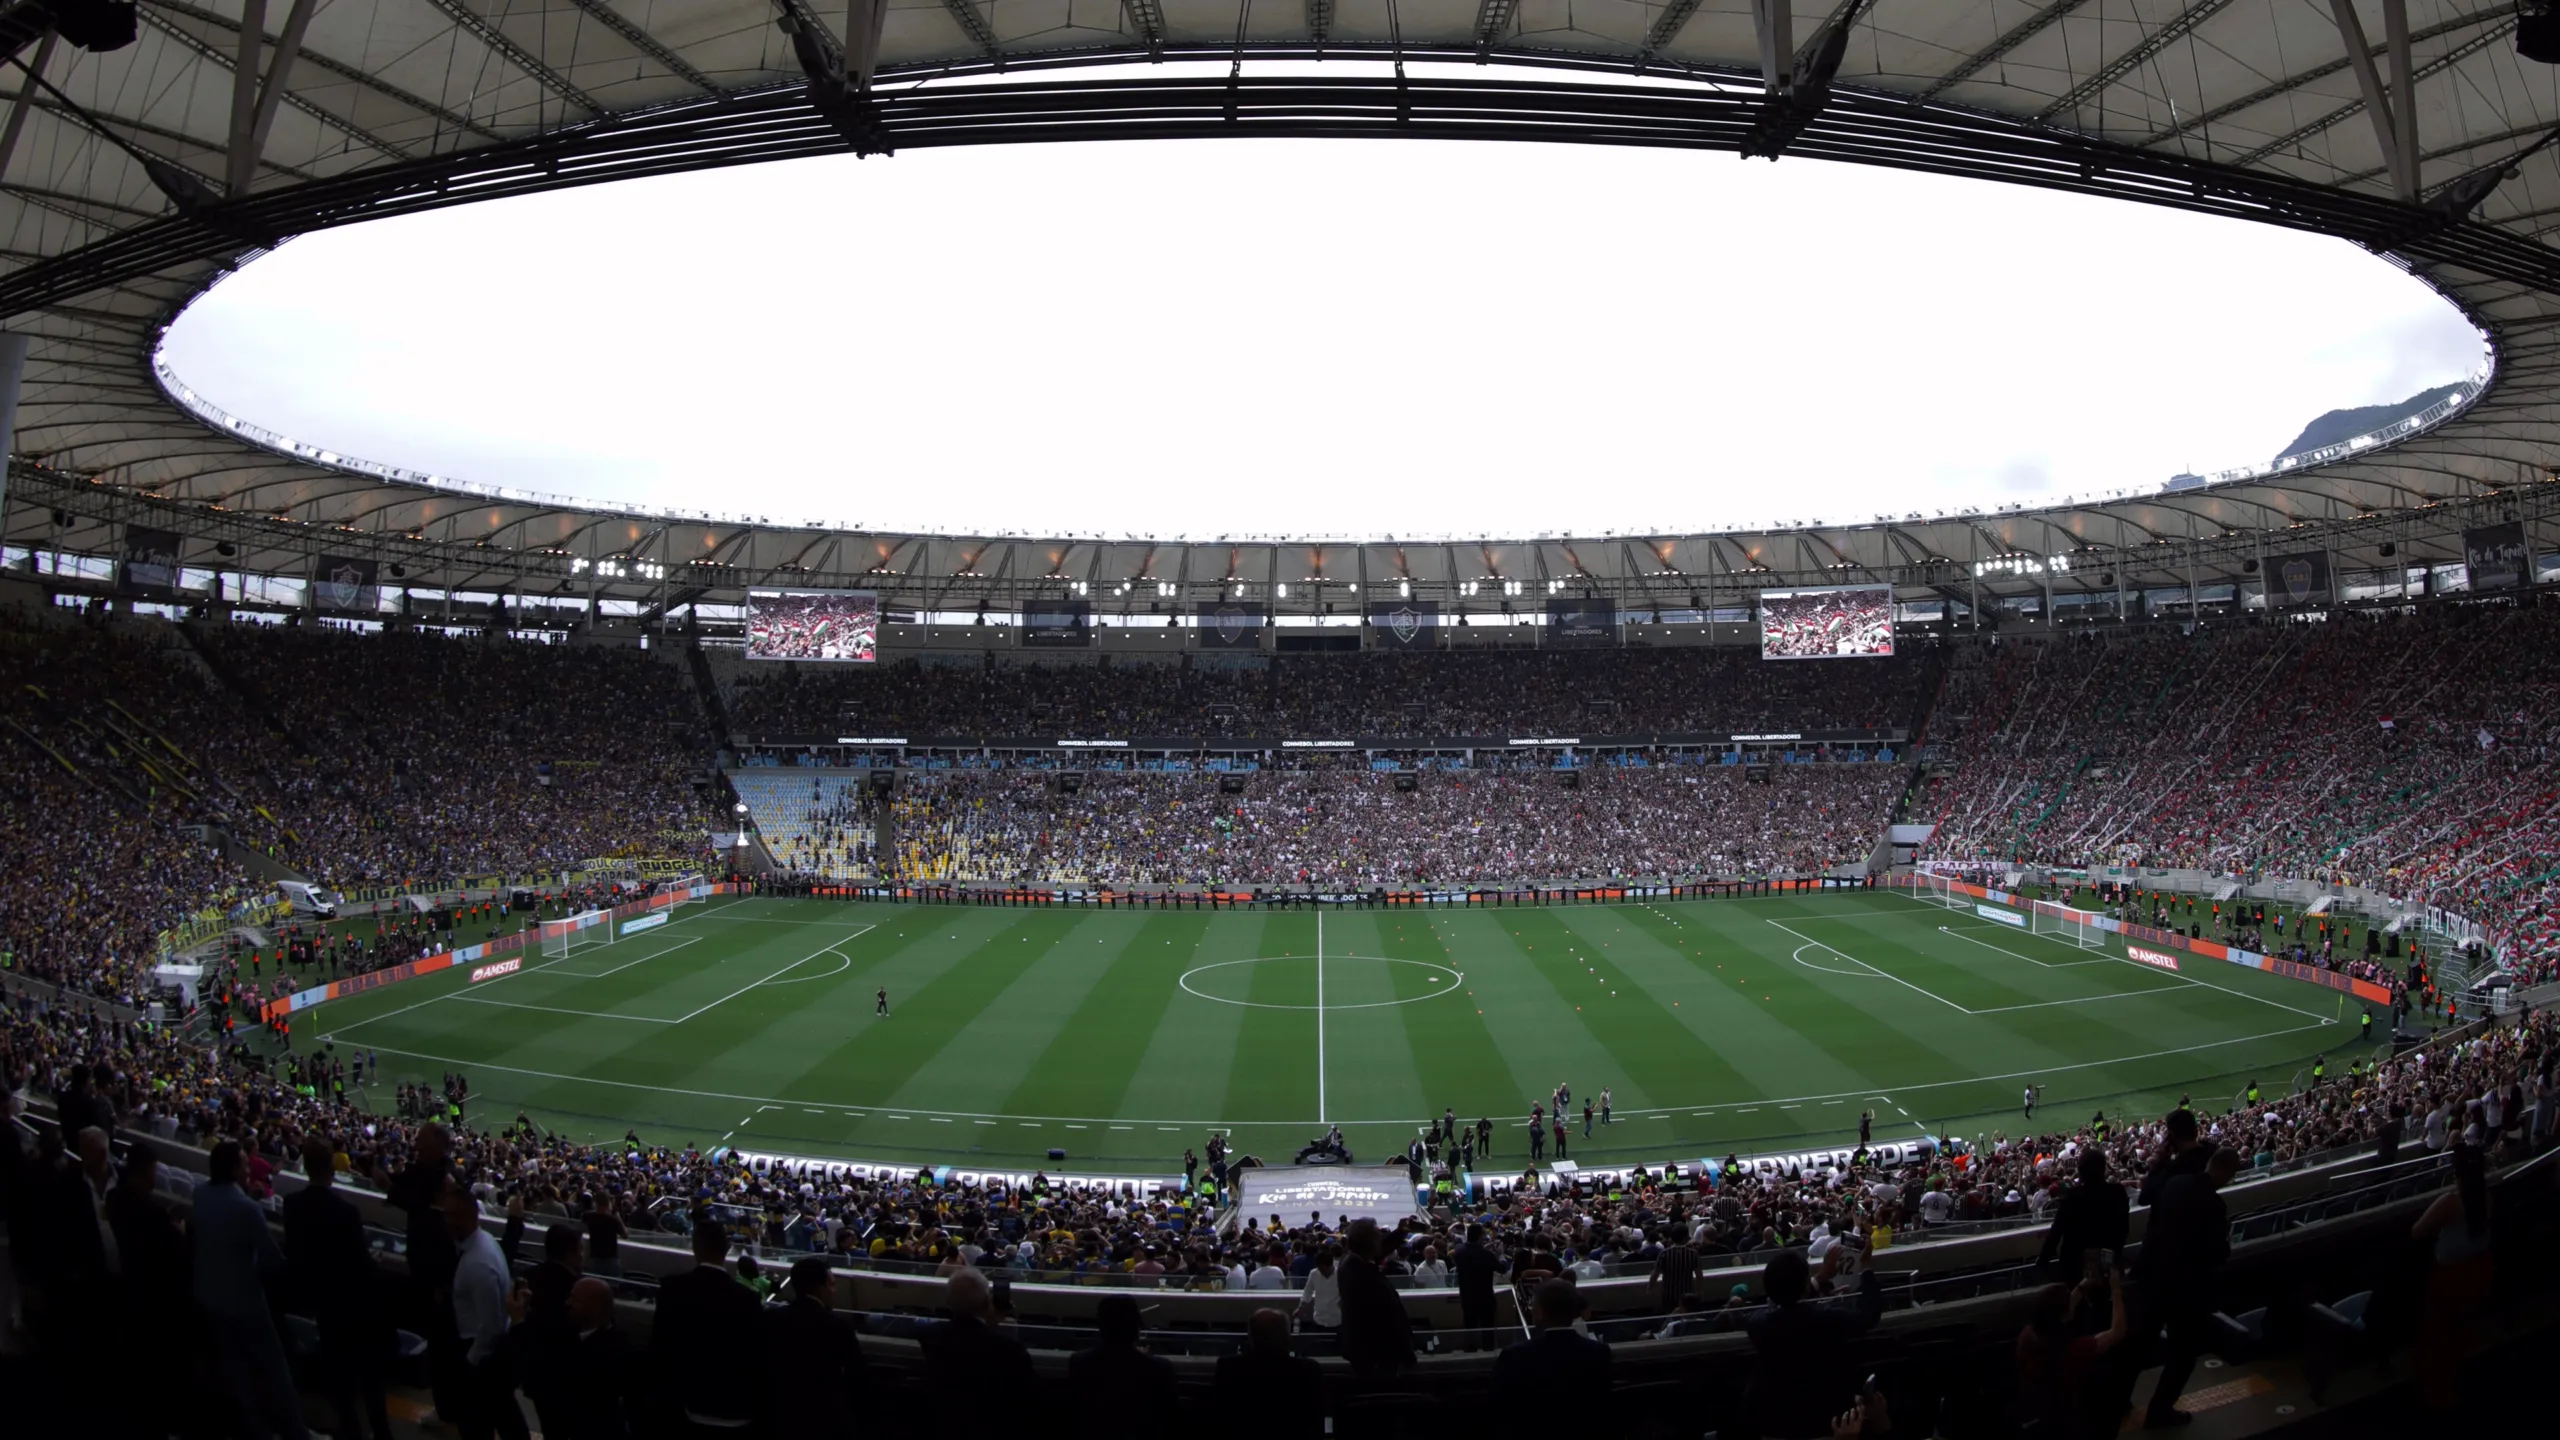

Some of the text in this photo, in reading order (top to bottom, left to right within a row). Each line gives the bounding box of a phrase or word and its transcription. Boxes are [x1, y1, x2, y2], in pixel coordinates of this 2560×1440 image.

[1979, 908, 2020, 923] sportingbet
[2425, 905, 2443, 934] FIEL
[2139, 950, 2177, 969] AMSTEL
[482, 959, 519, 978] AMSTEL
[1258, 1194, 1287, 1204] Rio
[1321, 1191, 1389, 1200] Janeiro
[1275, 1186, 1372, 1194] LIBERTADORES
